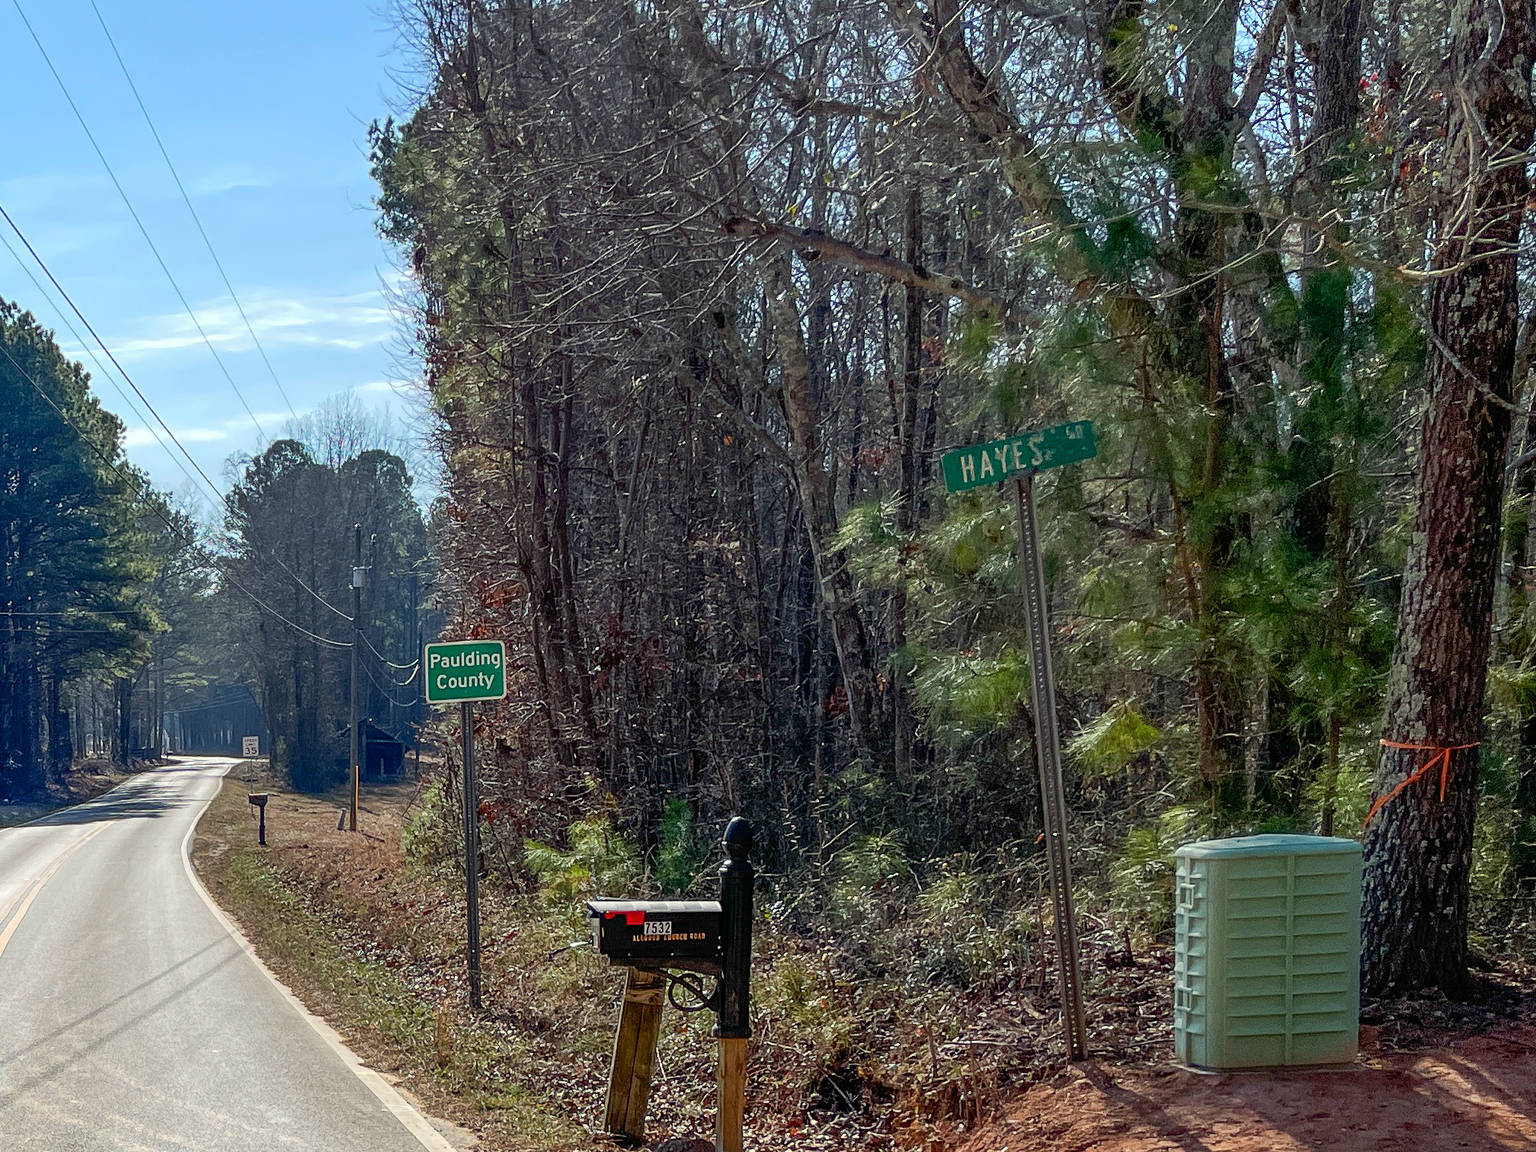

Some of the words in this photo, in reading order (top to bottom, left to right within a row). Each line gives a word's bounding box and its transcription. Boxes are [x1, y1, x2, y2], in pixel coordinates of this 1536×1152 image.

[960, 433, 1045, 483] HAYES
[430, 651, 501, 669] Paulding
[436, 672, 495, 690] County
[245, 747, 257, 755] 35
[645, 922, 671, 934] 7532
[689, 932, 706, 940] ROAD
